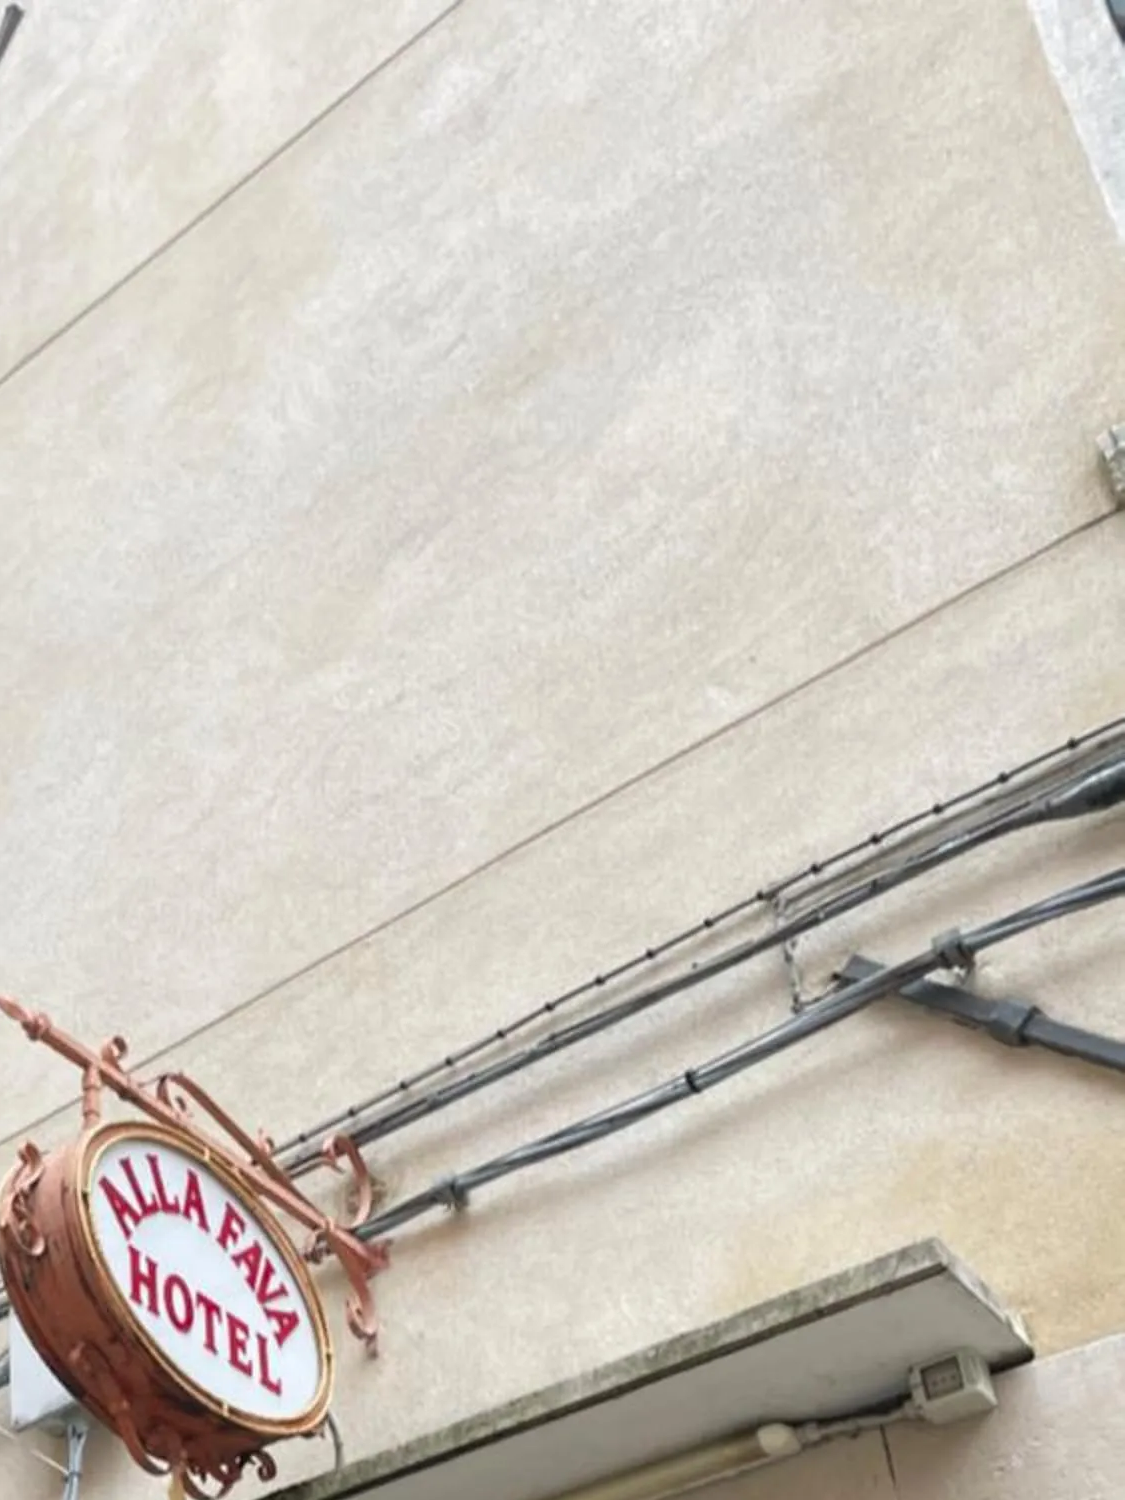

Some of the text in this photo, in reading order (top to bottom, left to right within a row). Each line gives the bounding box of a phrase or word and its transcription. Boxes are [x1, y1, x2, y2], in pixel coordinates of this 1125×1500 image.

[98, 1154, 300, 1347] ALLA FAVA
[127, 1245, 282, 1396] HOTEL
